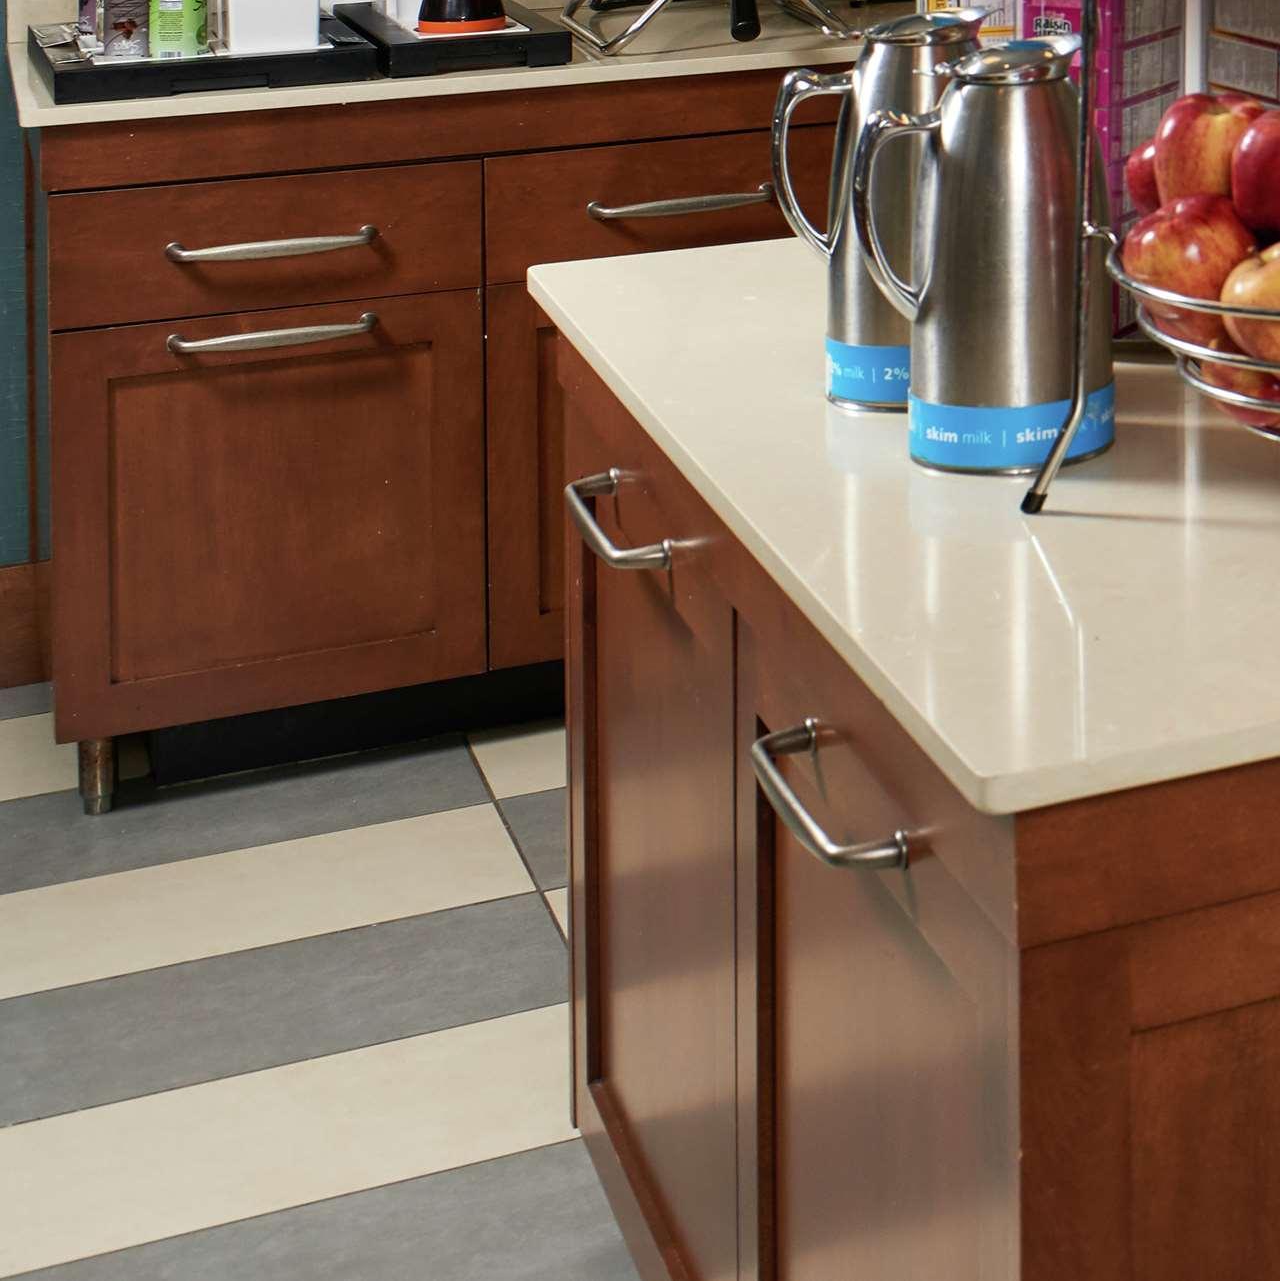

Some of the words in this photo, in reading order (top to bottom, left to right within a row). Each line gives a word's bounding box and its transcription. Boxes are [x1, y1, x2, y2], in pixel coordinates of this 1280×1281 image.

[1034, 19, 1071, 32] Raisin
[843, 363, 866, 381] milk
[925, 424, 959, 444] skim
[961, 430, 993, 445] milk
[1015, 426, 1058, 444] skim
